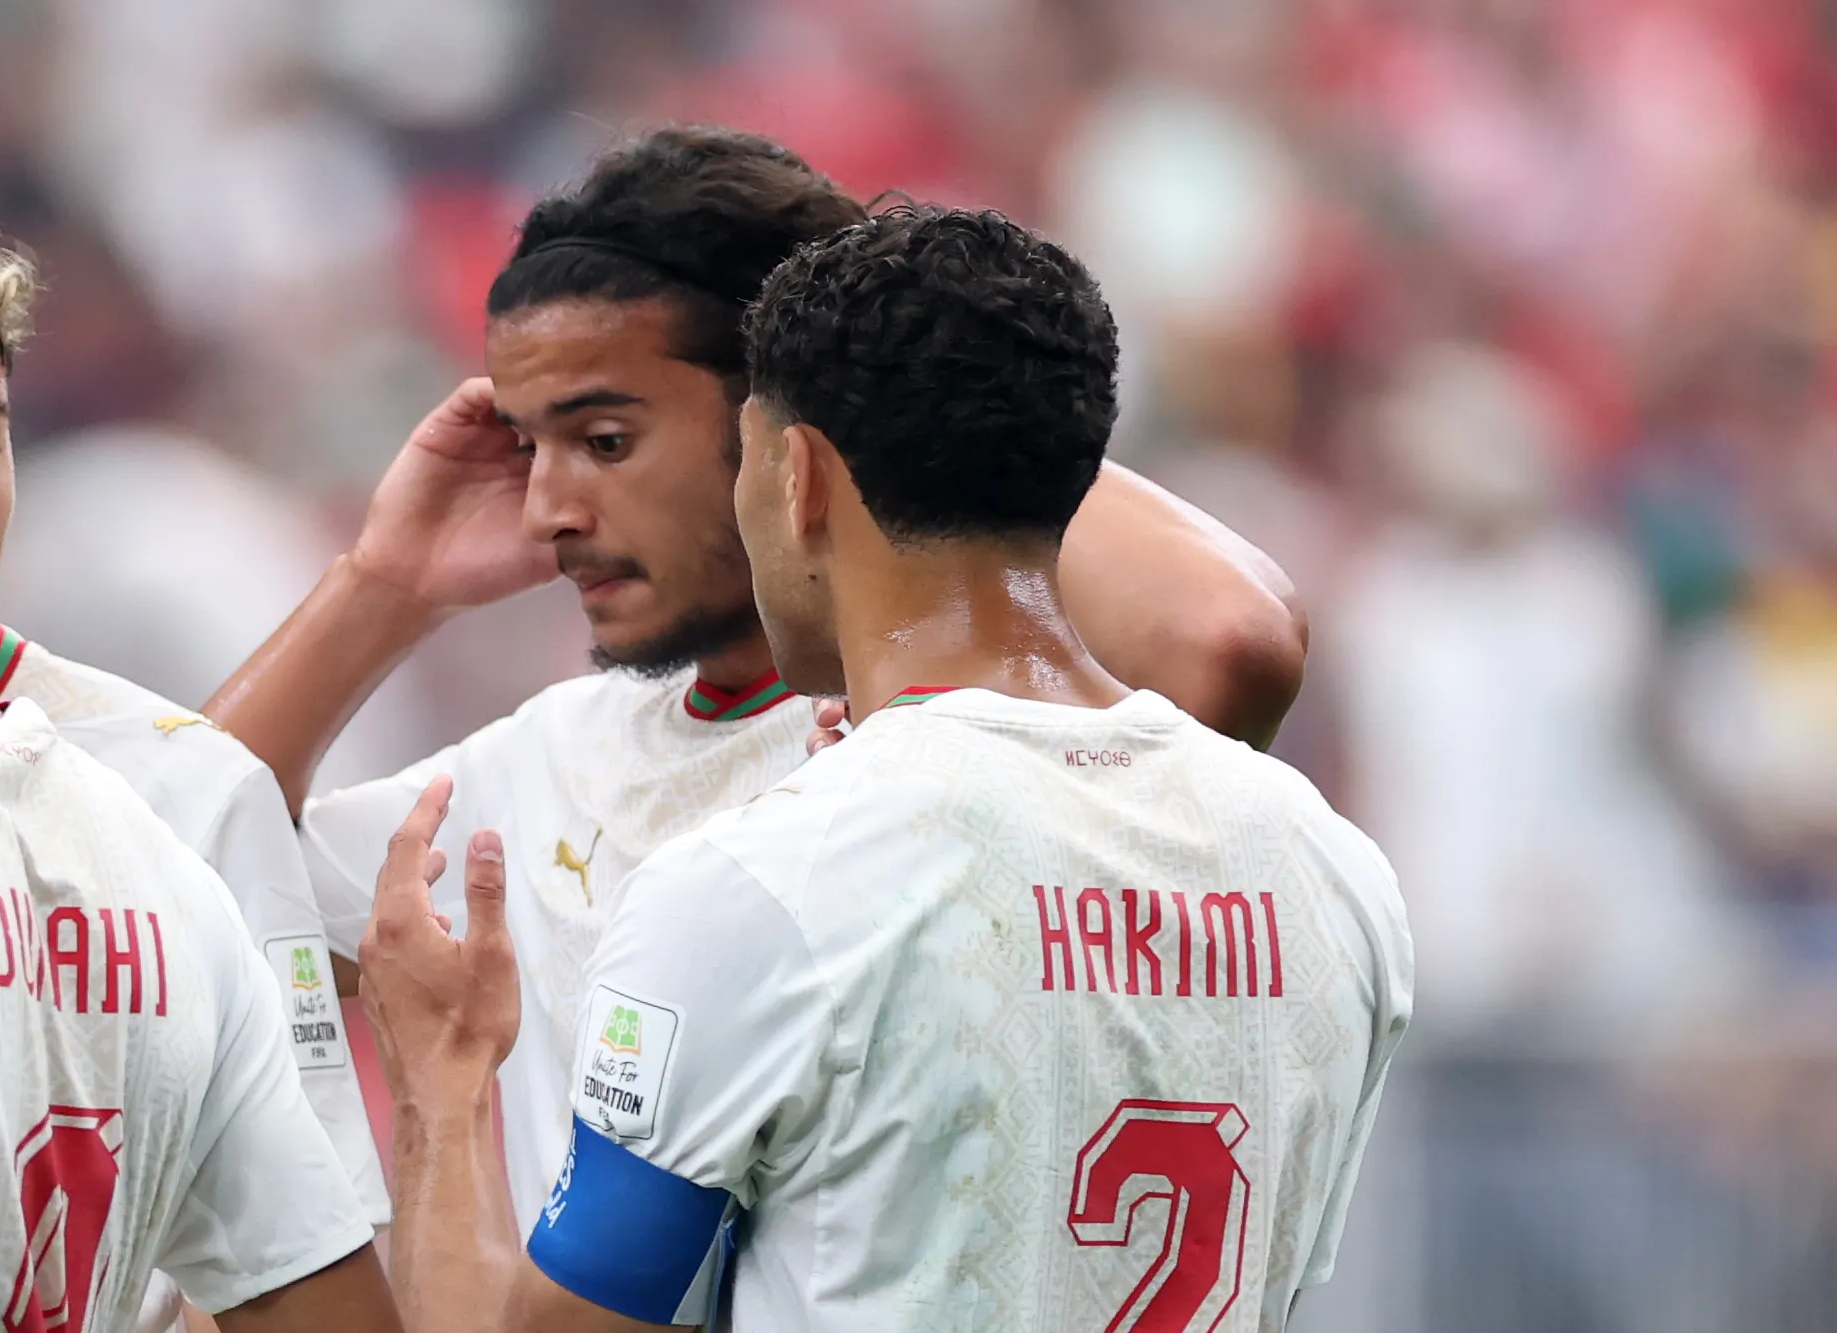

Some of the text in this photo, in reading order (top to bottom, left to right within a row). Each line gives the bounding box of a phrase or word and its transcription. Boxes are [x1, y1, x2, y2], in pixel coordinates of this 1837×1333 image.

[1032, 885, 1283, 998] HAKIMI
[591, 1049, 639, 1083] Unite For
